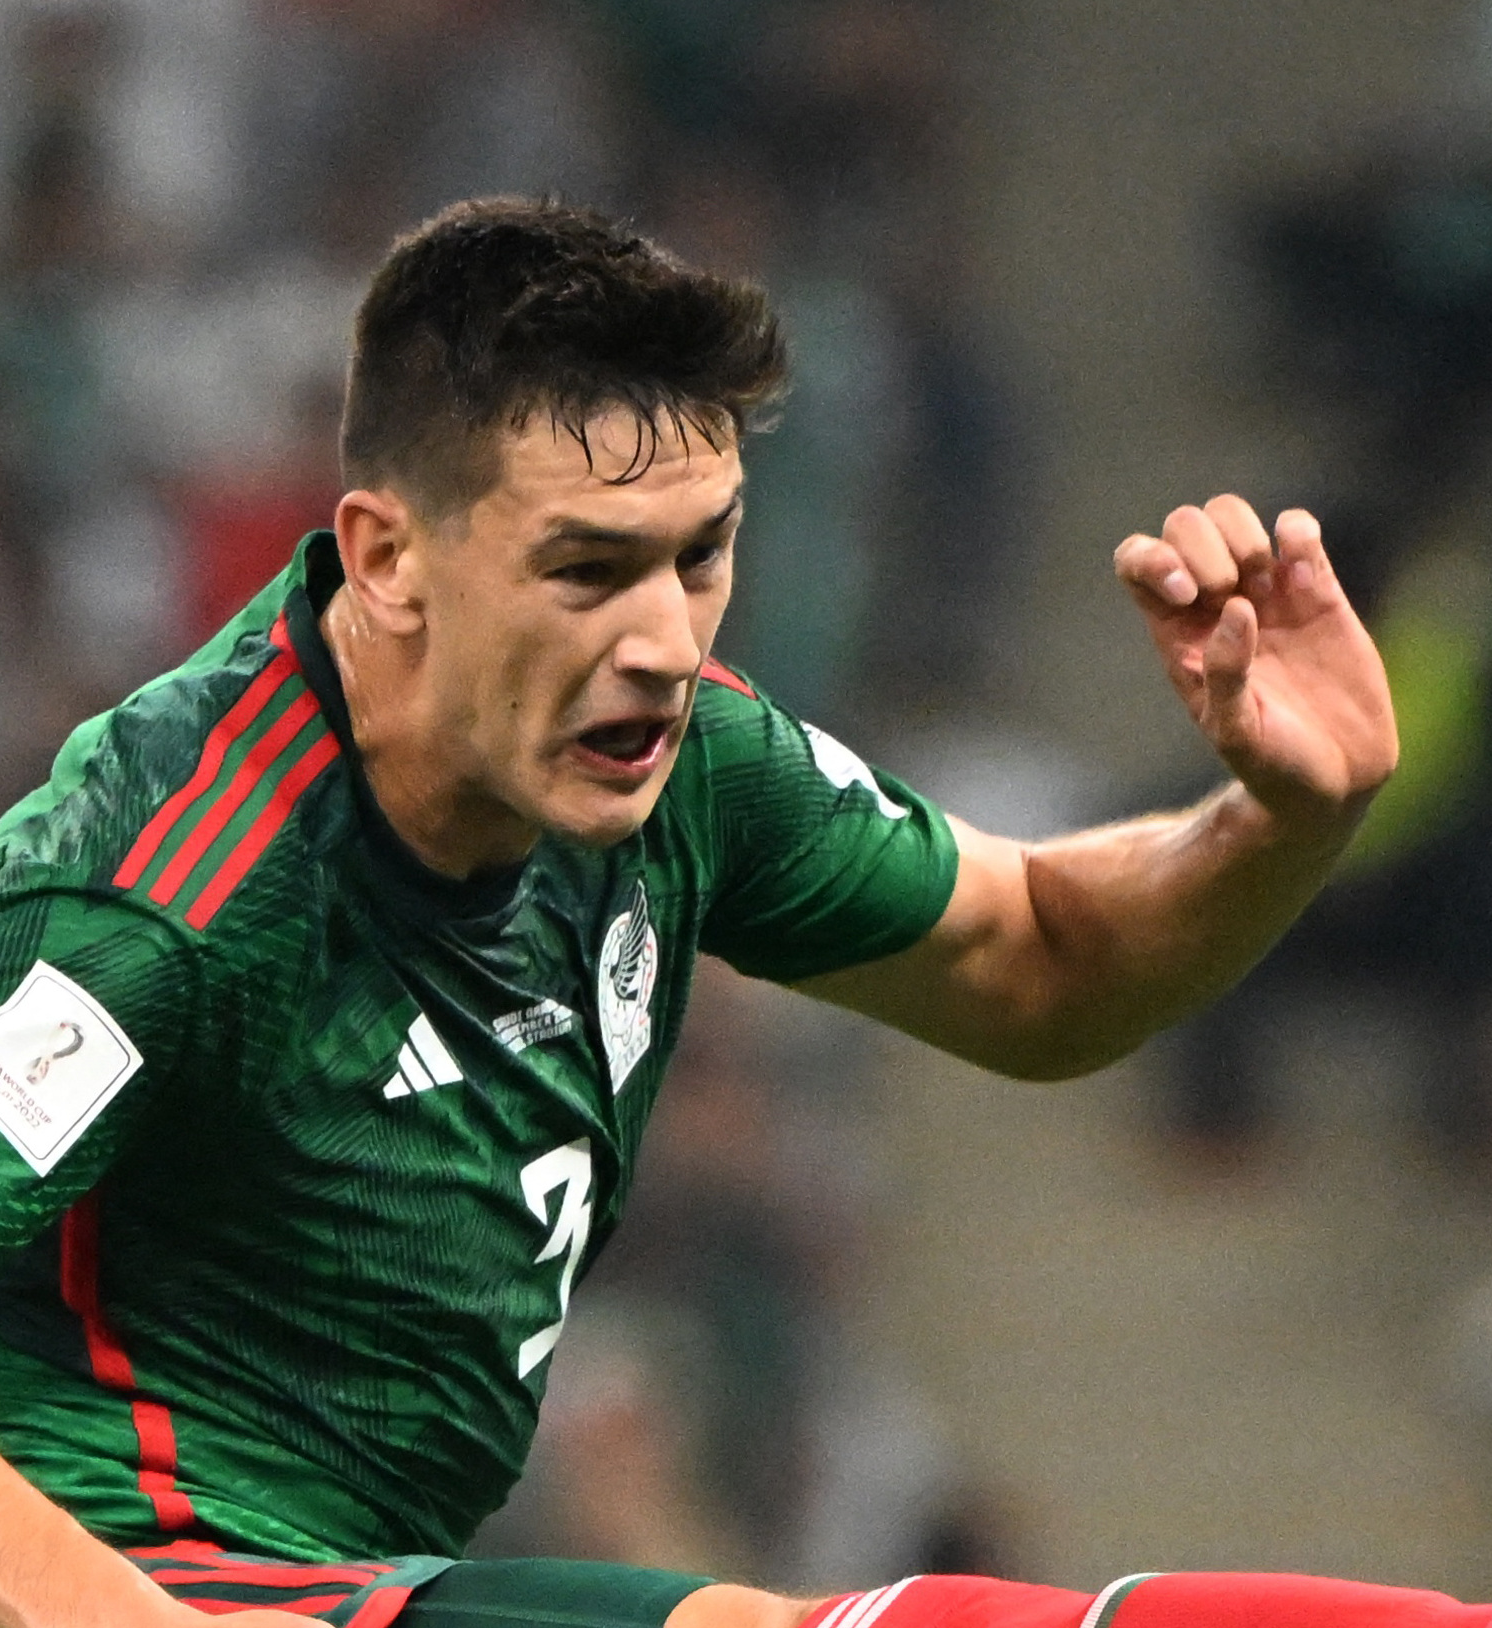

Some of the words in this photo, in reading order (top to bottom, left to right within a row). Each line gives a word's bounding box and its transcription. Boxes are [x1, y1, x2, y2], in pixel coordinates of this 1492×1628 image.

[3, 1072, 35, 1108] WORLD
[34, 1105, 52, 1124] CUP
[13, 1100, 40, 1128] 2022
